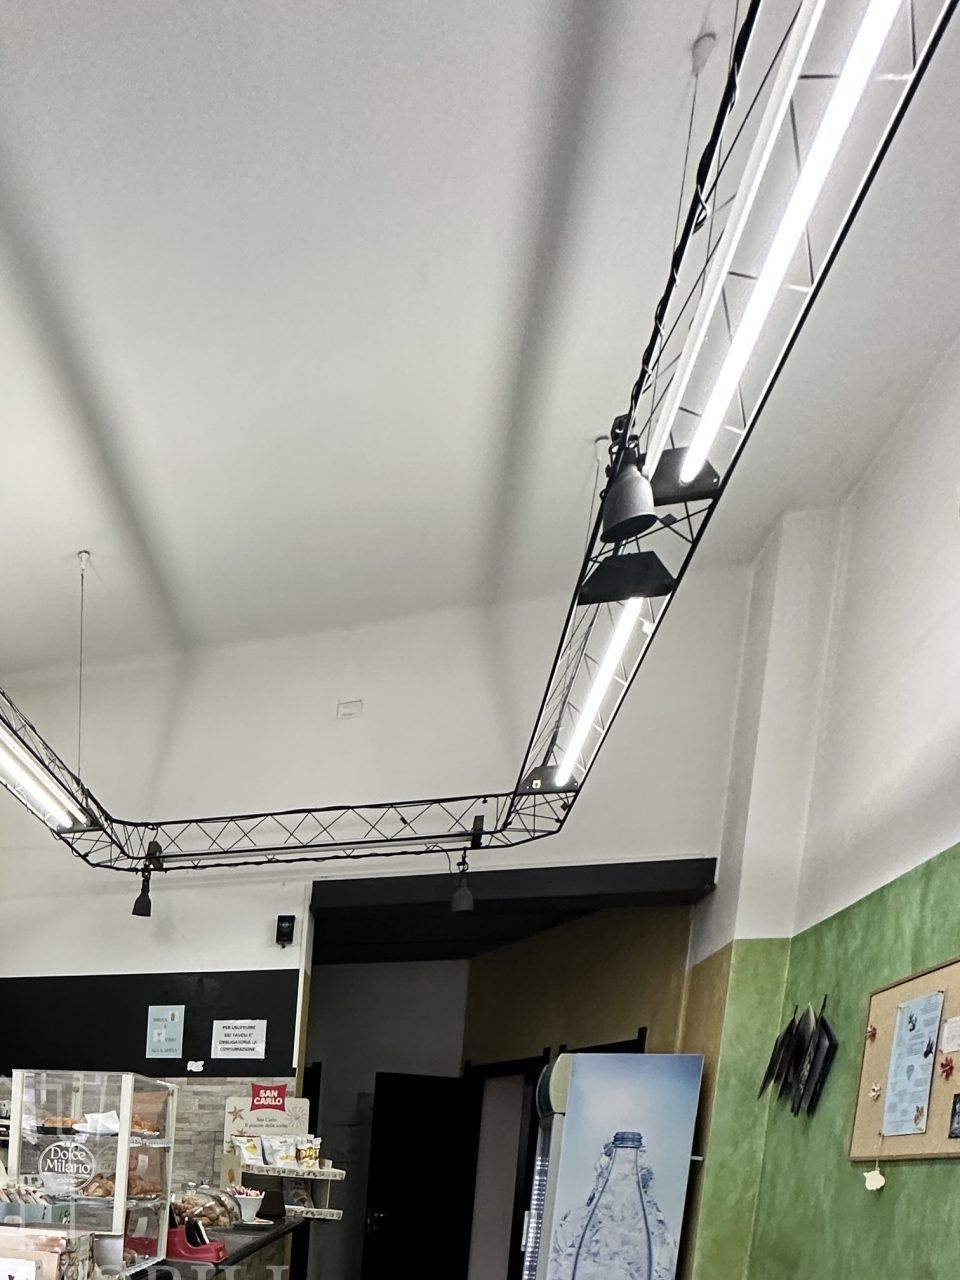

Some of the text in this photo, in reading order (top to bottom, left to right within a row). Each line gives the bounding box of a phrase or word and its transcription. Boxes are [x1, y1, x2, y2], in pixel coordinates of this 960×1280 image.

[259, 1089, 278, 1098] SAN
[253, 1097, 283, 1105] CARLO
[50, 1147, 86, 1160] Dolce
[44, 1159, 90, 1174] Milano
